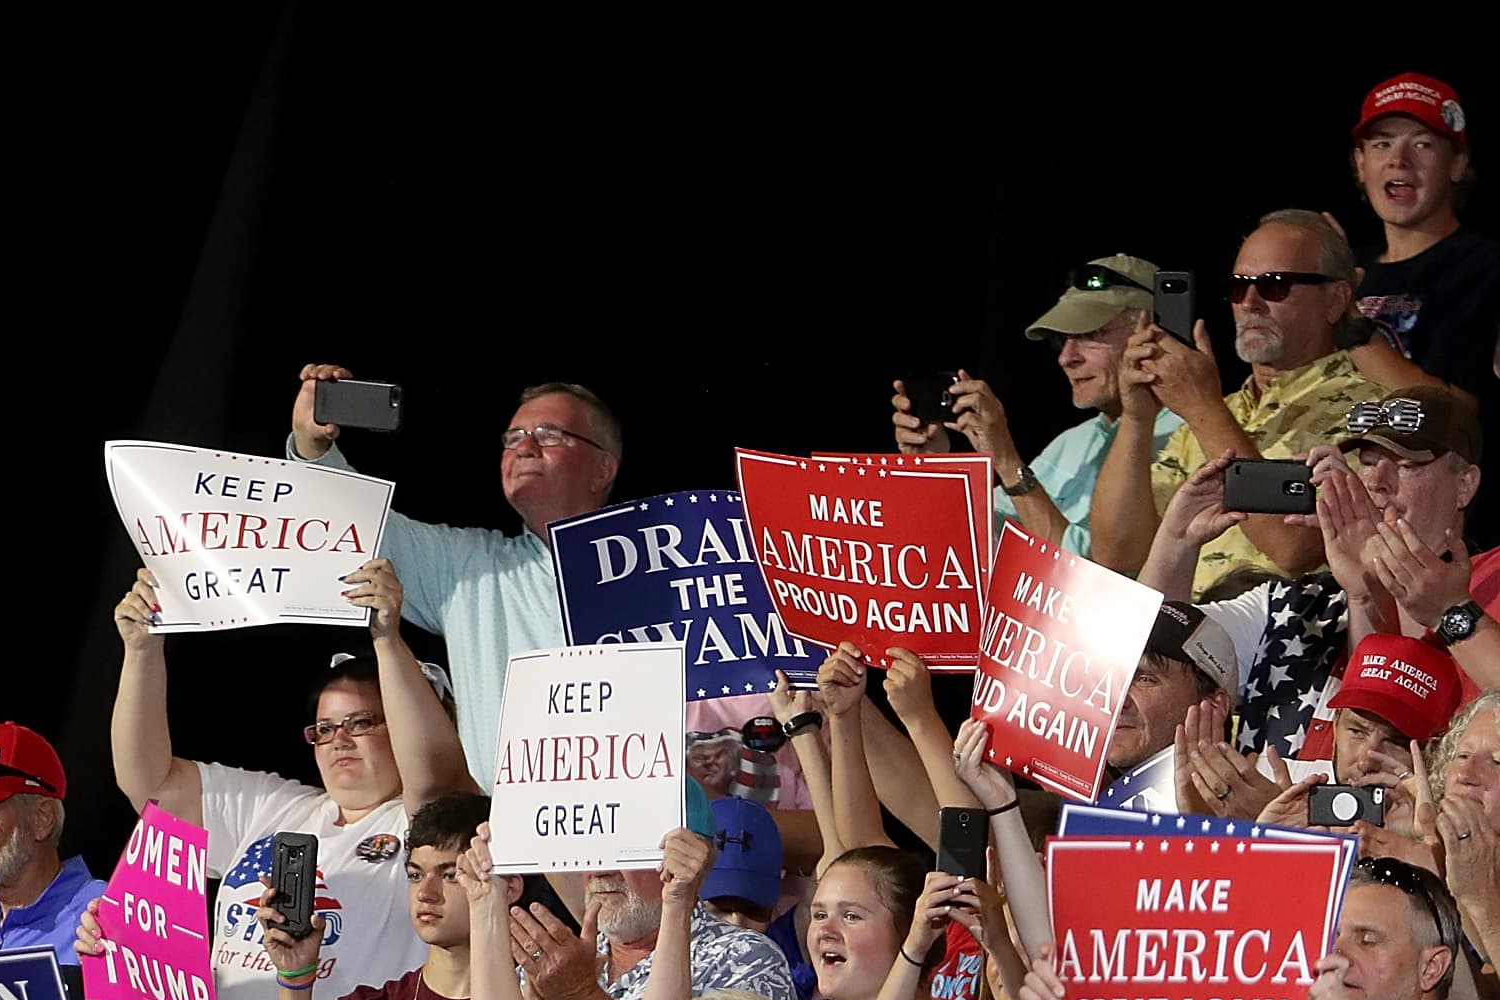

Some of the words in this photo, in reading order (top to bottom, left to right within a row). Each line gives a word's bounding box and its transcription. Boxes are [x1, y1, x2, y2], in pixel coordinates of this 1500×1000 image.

[194, 472, 293, 503] KEEP
[809, 493, 884, 527] MAKE
[136, 512, 366, 556] AMERICA
[590, 517, 754, 585] DRAI
[761, 526, 974, 590] AMERICA
[185, 567, 291, 601] GREAT
[670, 573, 748, 611] THE
[773, 578, 858, 626] PROUD
[867, 599, 970, 634] AGAIN
[1012, 572, 1074, 624] MAKE
[980, 604, 1114, 716] MERICA
[1362, 655, 1387, 666] MAKE
[1390, 660, 1438, 691] AMERICA
[548, 681, 613, 715] KEEP
[1007, 692, 1100, 759] AGAIN
[496, 731, 675, 785] AMERICA
[535, 802, 621, 837] GREAT
[126, 819, 207, 896] OMEN
[124, 891, 168, 940] FOR
[1136, 878, 1231, 912] MAKE
[219, 941, 240, 965] for
[241, 949, 274, 971] the
[1059, 928, 1315, 986] AMERICA
